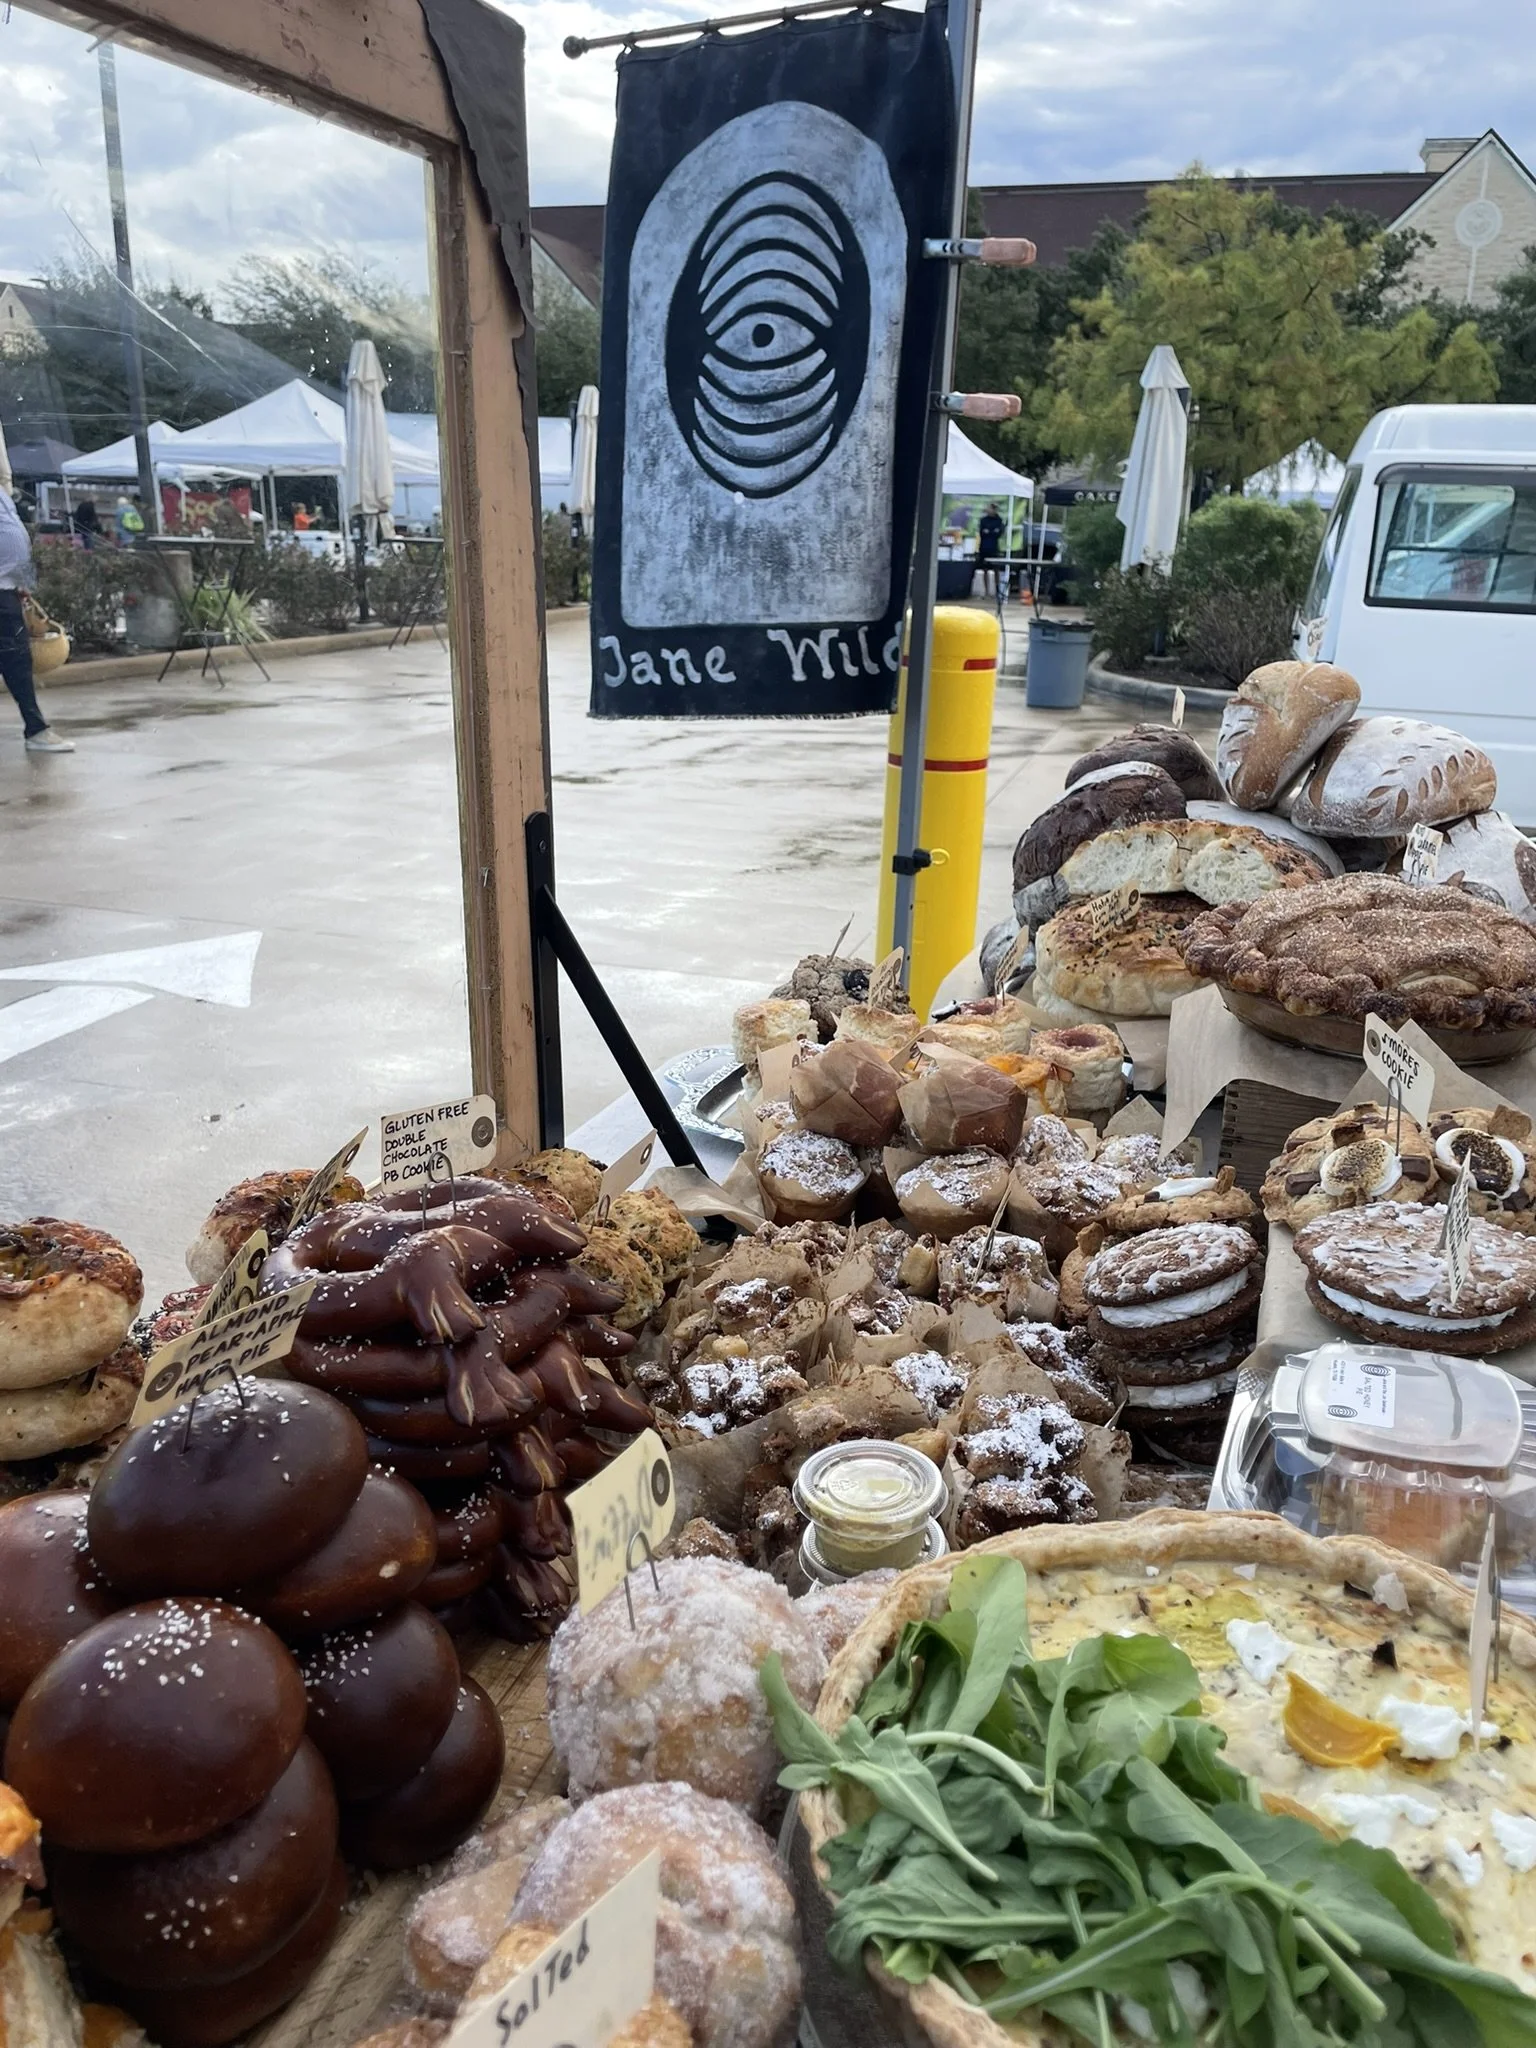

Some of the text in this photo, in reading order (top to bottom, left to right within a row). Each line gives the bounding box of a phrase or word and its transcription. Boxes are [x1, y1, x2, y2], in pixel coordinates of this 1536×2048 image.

[600, 635, 737, 688] Jane
[1382, 1051, 1415, 1089] COOKIE
[384, 1101, 470, 1135] GLUTEN FREE
[382, 1137, 449, 1167] CHOCOLATE
[384, 1128, 427, 1153] DOUBLE
[383, 1155, 445, 1185] PB COOKIE
[190, 1294, 290, 1350] ALMOND
[238, 1333, 282, 1366] PIE
